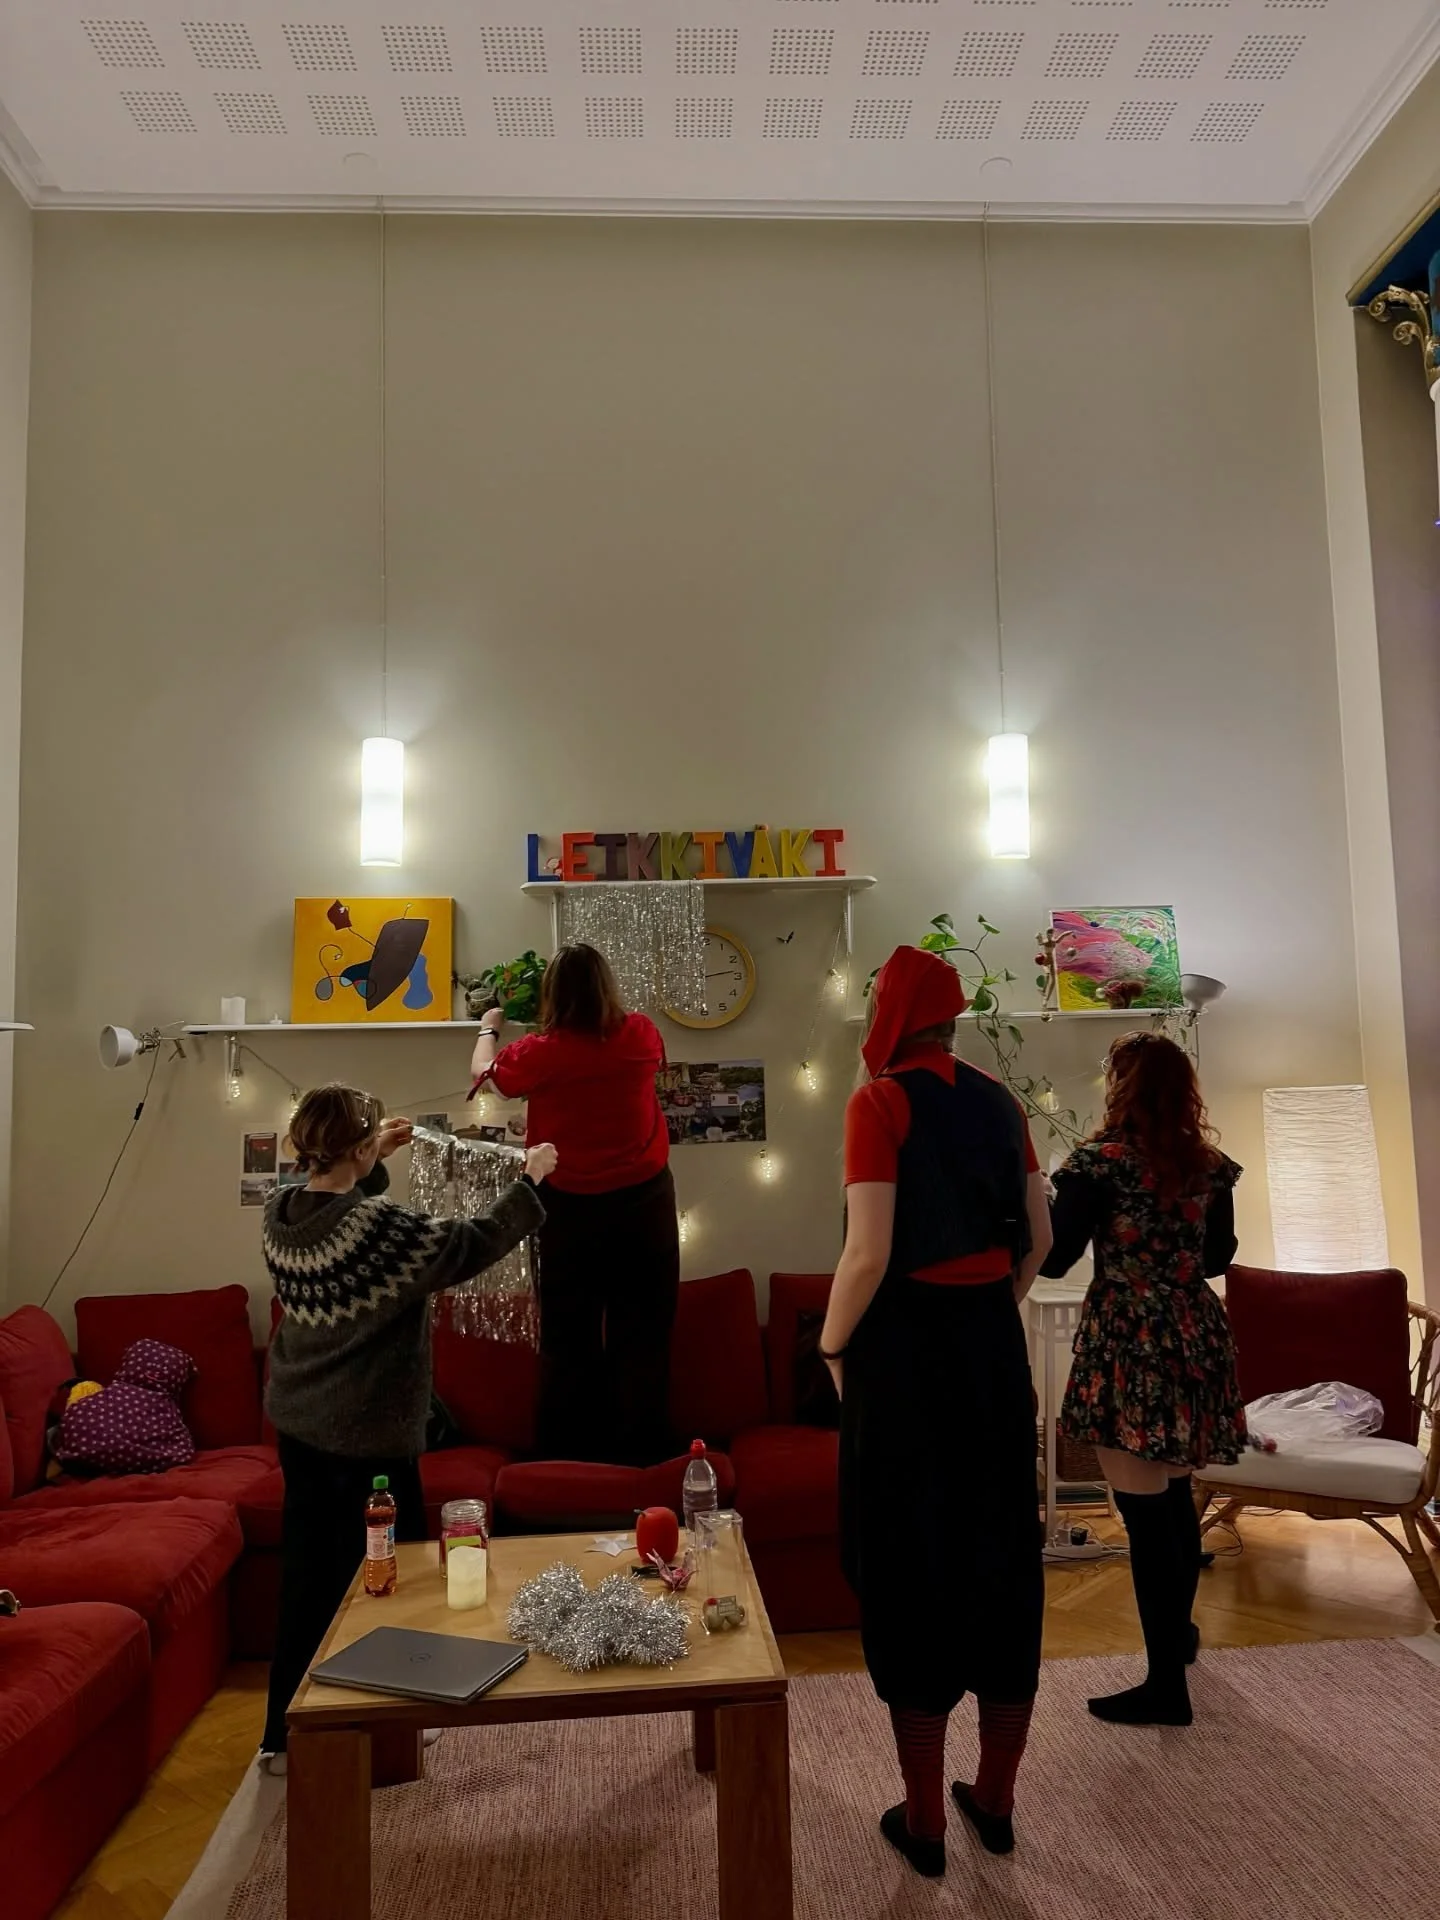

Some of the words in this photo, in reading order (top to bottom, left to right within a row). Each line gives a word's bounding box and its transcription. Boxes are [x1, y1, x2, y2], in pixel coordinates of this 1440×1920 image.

[527, 824, 846, 882] LEIKKIVÄKI
[720, 943, 724, 951] 1
[729, 956, 738, 964] 2
[729, 989, 737, 997] 4
[719, 1003, 727, 1011] 5
